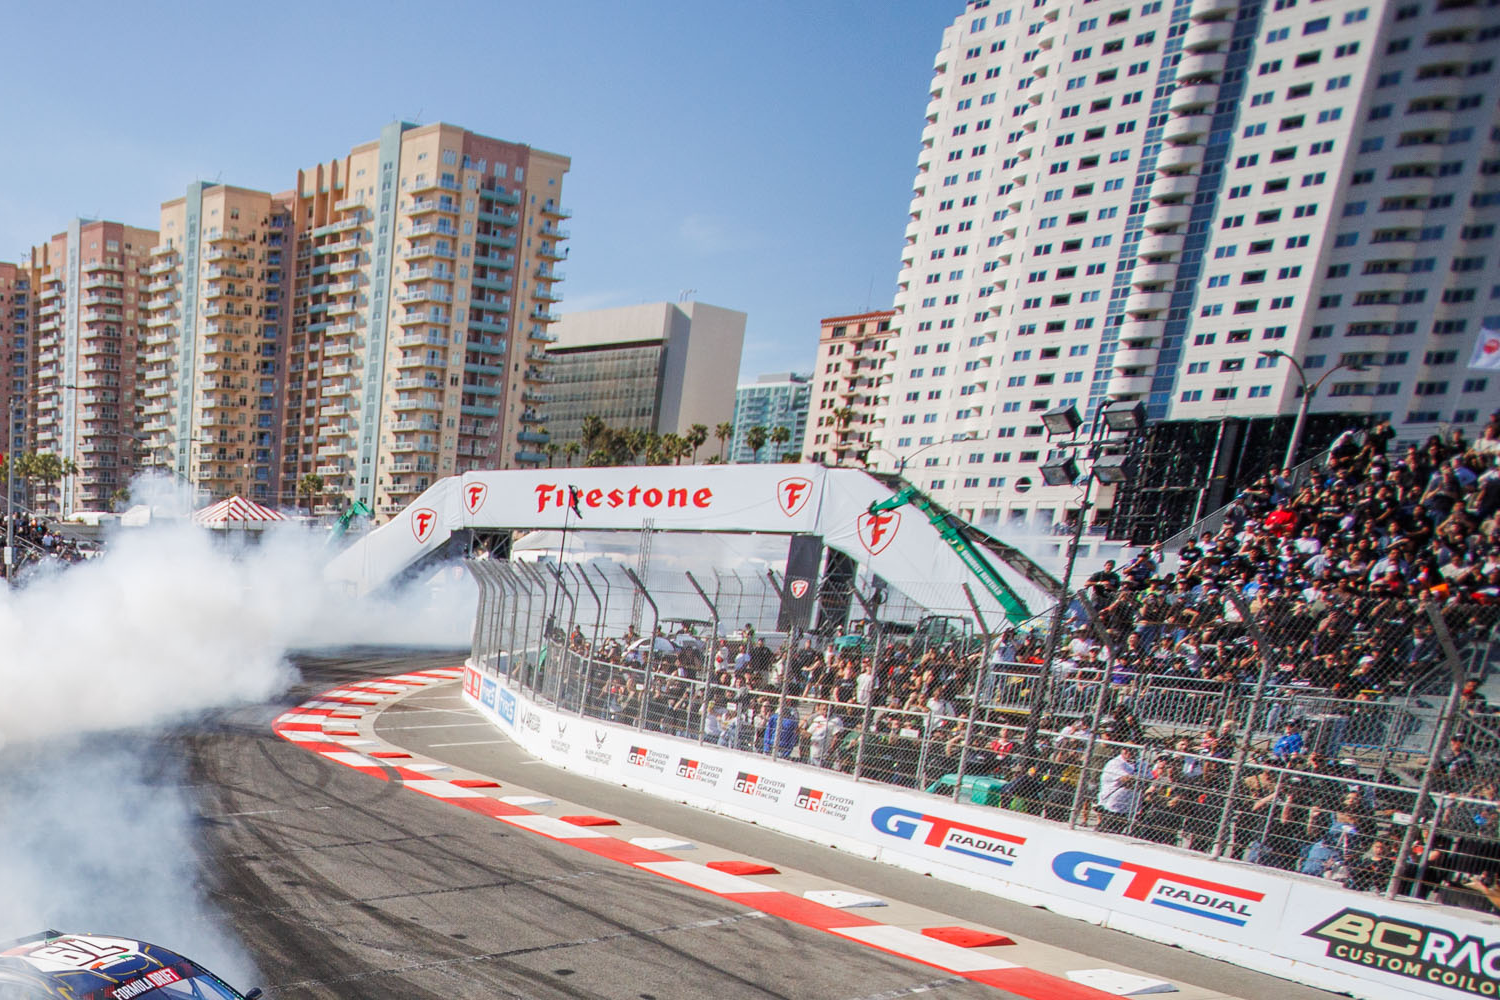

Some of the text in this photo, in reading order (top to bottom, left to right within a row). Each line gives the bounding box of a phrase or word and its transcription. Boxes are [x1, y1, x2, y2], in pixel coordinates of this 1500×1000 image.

[534, 484, 713, 513] Firestone
[627, 752, 646, 767] GR
[676, 765, 697, 780] GR
[733, 779, 756, 796] GR
[759, 776, 785, 789] TOYOTA
[794, 795, 820, 812] GR
[822, 800, 849, 813] GAZOO
[824, 793, 854, 806] TOYOTA
[820, 807, 847, 821] Racing
[949, 833, 1018, 858] RADIAL
[1156, 885, 1252, 917] RADIAL
[1335, 945, 1423, 977] CUSTOM
[152, 968, 180, 988] DRIFT
